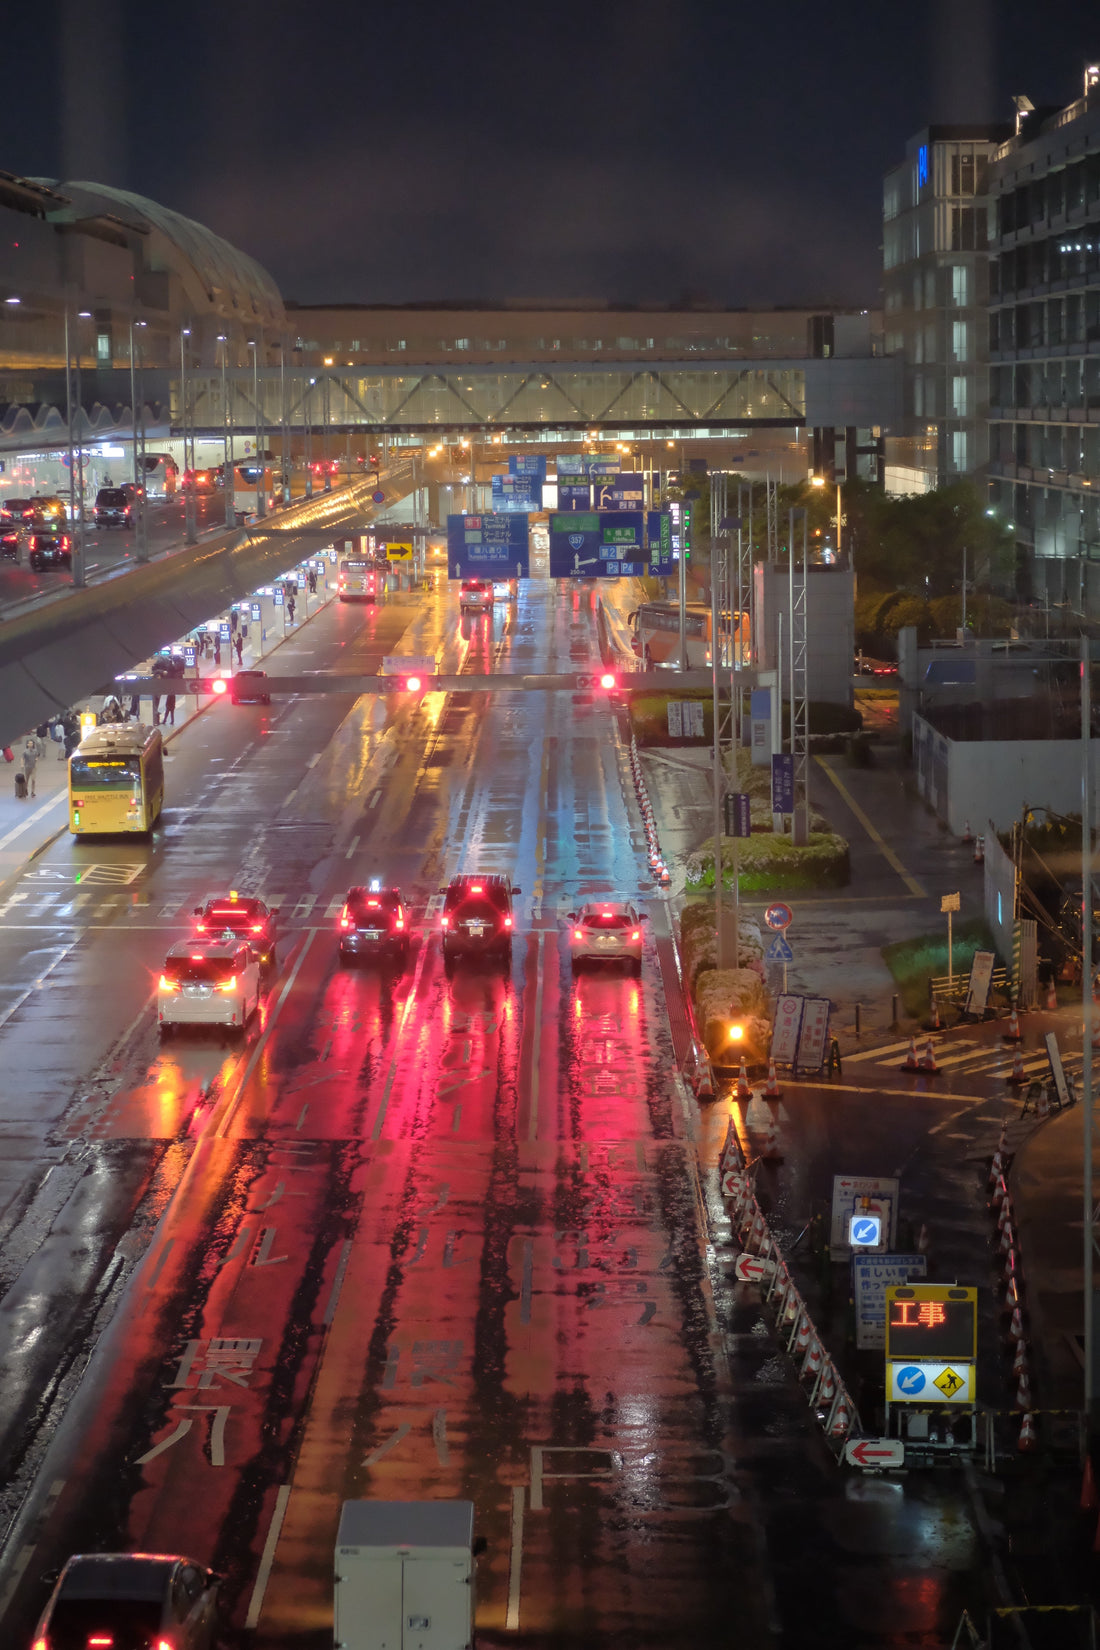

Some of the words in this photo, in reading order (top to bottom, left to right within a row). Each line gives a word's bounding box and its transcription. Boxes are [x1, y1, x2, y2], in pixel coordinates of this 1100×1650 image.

[919, 145, 928, 188] P4
[570, 536, 582, 544] 357
[890, 1301, 946, 1328] 工事
